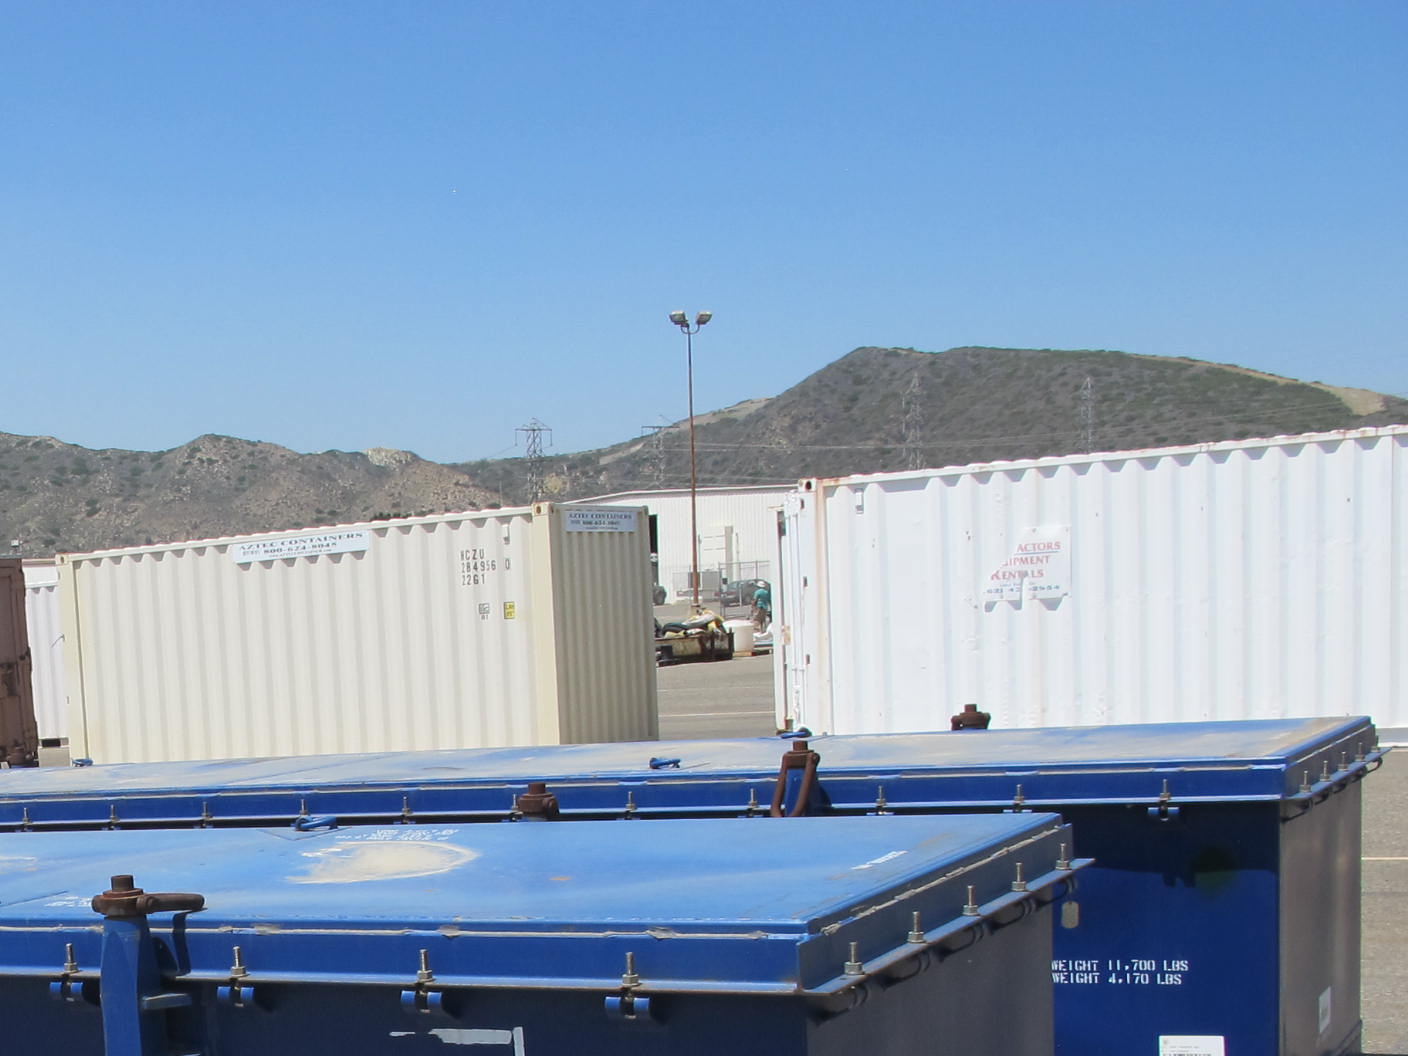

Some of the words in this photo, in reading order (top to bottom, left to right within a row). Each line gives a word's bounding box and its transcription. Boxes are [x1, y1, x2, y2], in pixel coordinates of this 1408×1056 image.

[239, 541, 277, 551] AZTEC
[281, 532, 364, 546] CONTAINERS
[1017, 541, 1061, 552] ACTORS
[1052, 959, 1099, 972] WEIGHT
[1108, 959, 1156, 971] 11,700
[1163, 959, 1189, 972] LBS
[1052, 972, 1100, 984] WEIGHT
[1108, 972, 1149, 985] 4,170
[1156, 973, 1182, 985] LBS
